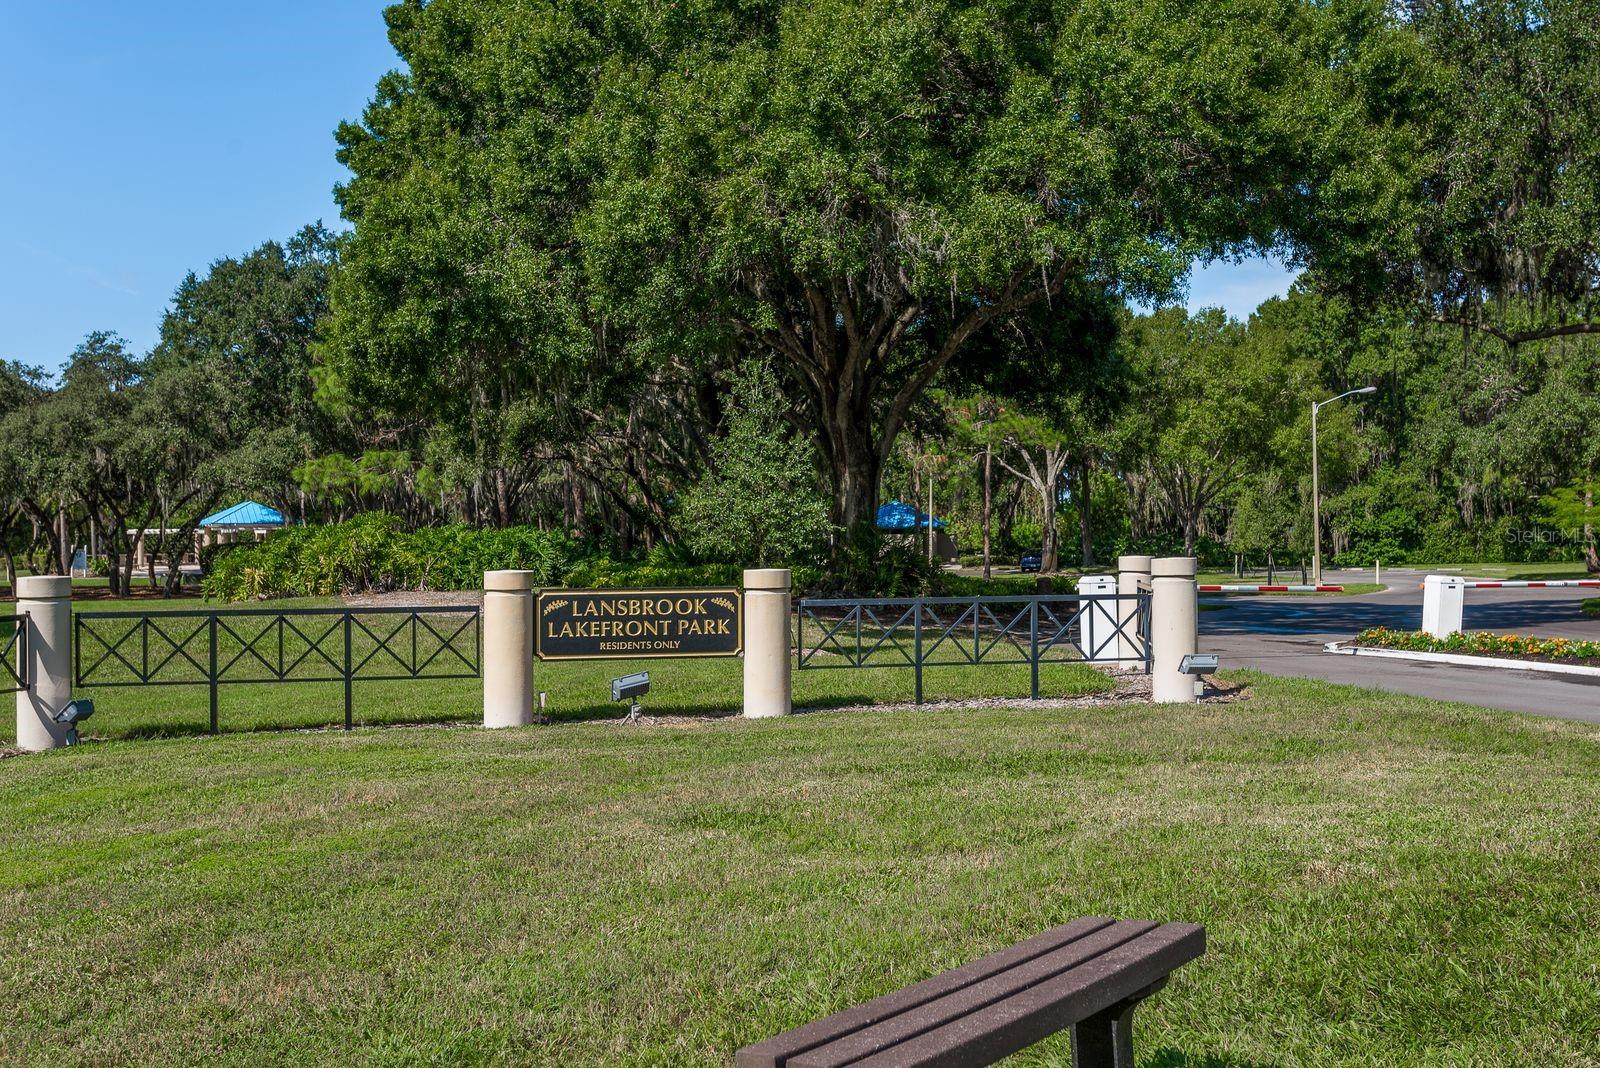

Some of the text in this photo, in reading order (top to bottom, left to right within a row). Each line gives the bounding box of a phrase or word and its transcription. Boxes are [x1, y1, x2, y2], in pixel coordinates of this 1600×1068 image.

[572, 599, 707, 617] LANSBROOK
[547, 618, 730, 638] LAKEFRONT PARK
[600, 640, 681, 650] RESIDENTS ONLY
